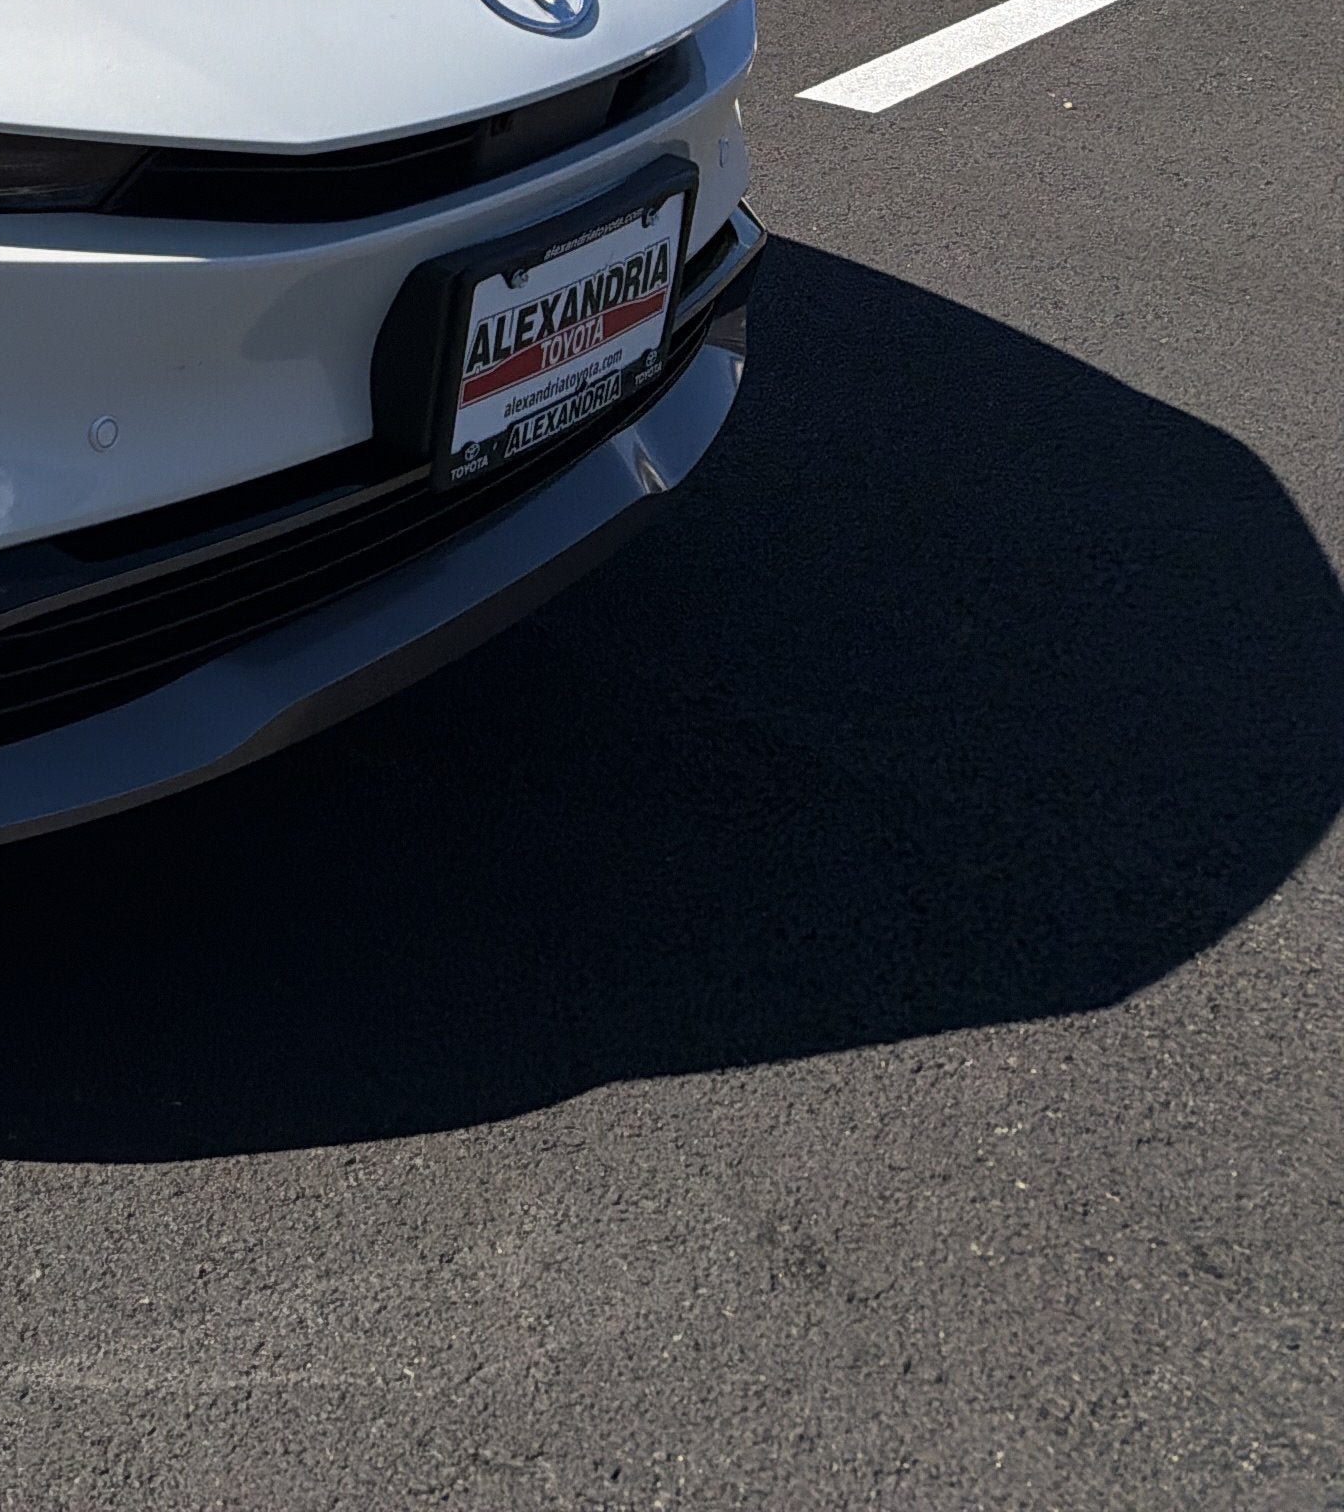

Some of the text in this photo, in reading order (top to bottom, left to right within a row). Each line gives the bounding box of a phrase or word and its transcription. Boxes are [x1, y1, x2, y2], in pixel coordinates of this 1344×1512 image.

[465, 240, 669, 375] ALEXANDRIA
[540, 315, 604, 369] TOYOTA
[503, 349, 623, 418] alexandriatoyota.com
[504, 369, 621, 458] ALEXANDRIA
[450, 454, 489, 481] TOYOTA
